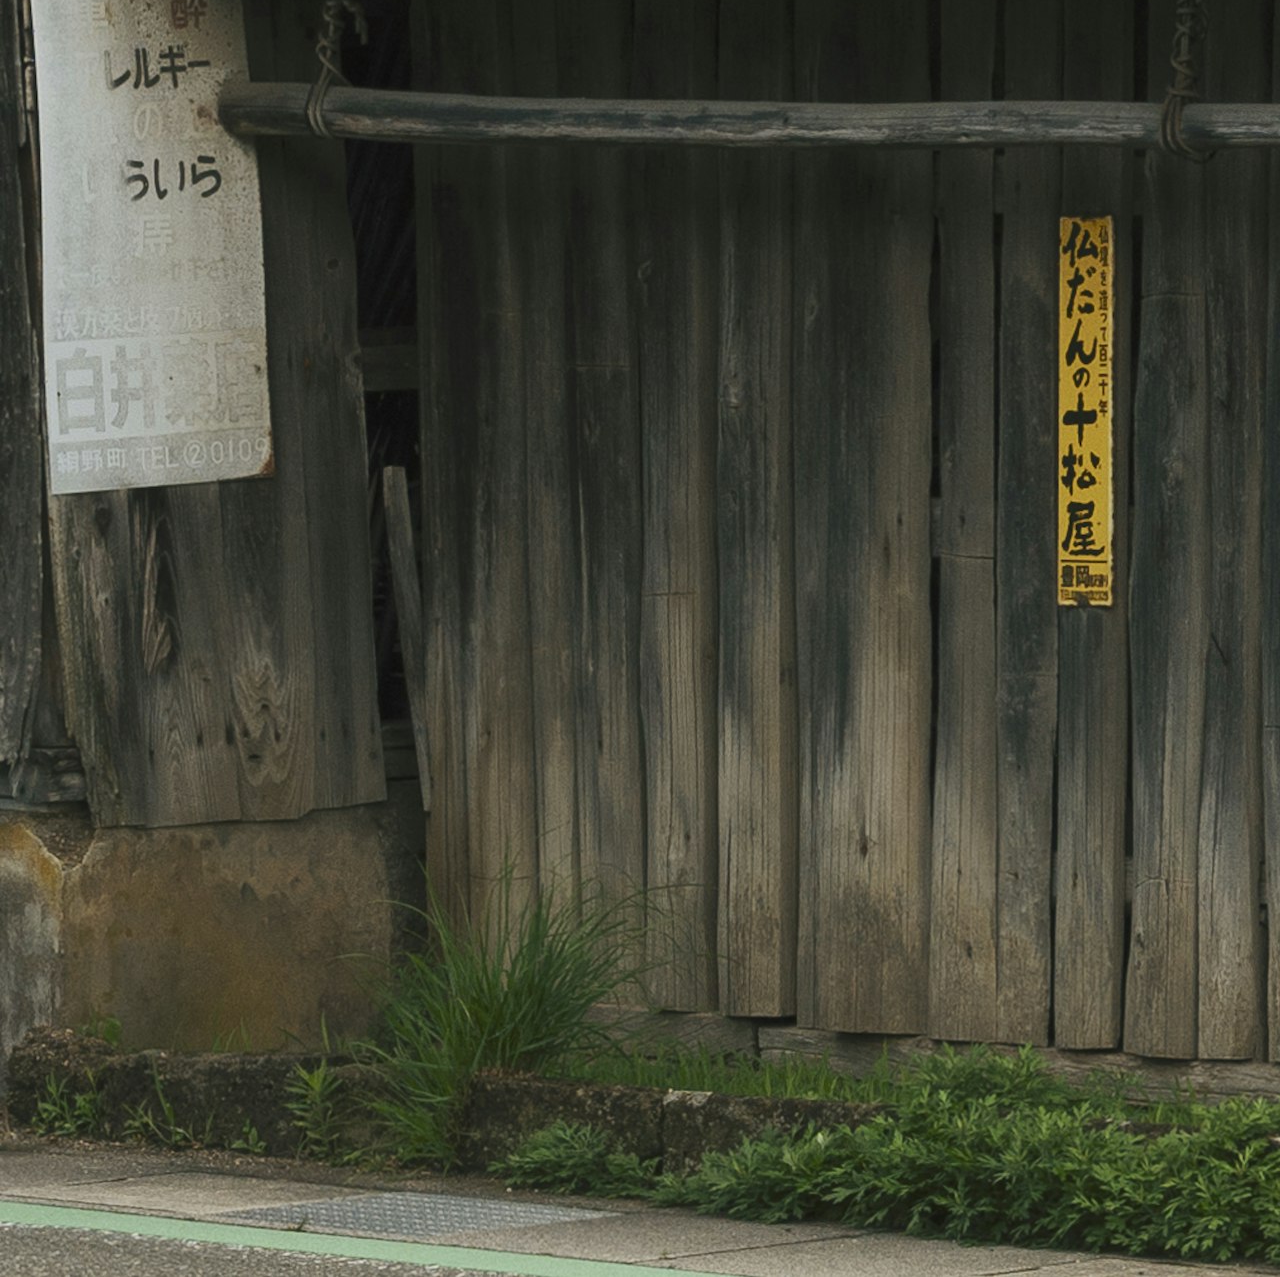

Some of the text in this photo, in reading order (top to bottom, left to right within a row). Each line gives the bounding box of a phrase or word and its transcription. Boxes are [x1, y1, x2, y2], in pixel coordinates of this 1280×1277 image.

[100, 45, 211, 90] レルギー
[1061, 221, 1105, 557] 仏だんの十松屋
[136, 445, 180, 470] TEL
